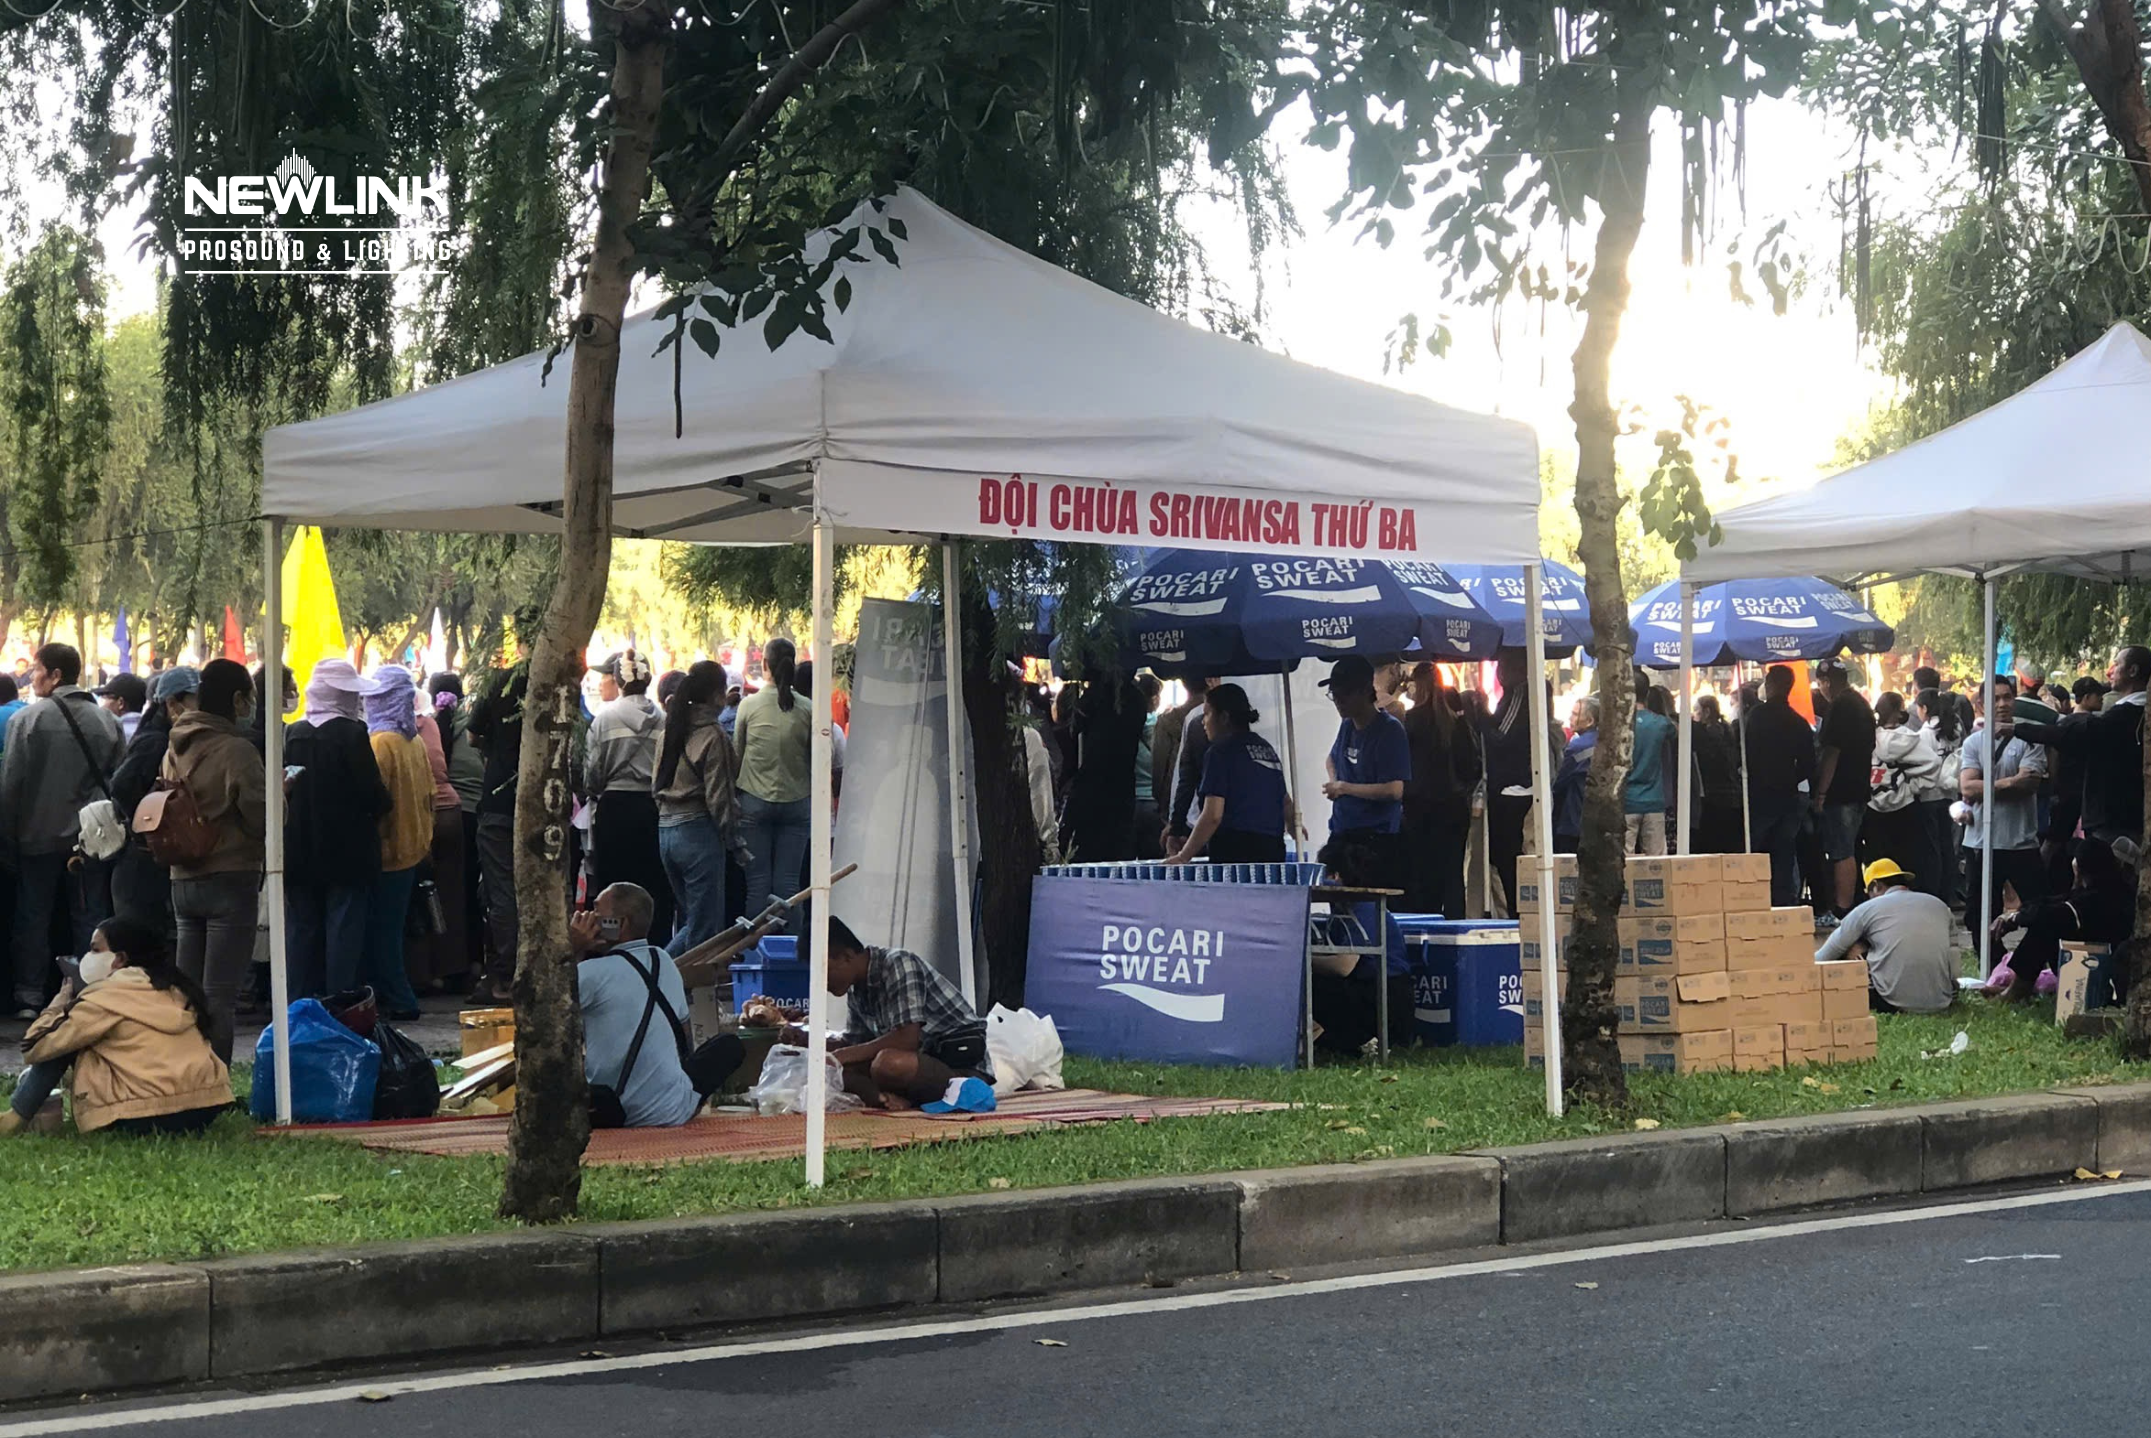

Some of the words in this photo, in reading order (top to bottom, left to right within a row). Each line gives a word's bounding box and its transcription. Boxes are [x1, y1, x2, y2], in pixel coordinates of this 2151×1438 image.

[979, 473, 1038, 535] ĐỘI
[1050, 481, 1139, 535] CHÙA
[1149, 491, 1301, 545] SRIVANSA
[1311, 500, 1374, 549] THỨ
[1378, 507, 1417, 551] BA
[1251, 558, 1365, 576] POCARI
[1136, 567, 1239, 589] POCARI
[1256, 568, 1358, 589] SWEAT
[1393, 569, 1449, 586] SWEAT
[1130, 581, 1225, 602] SWEAT
[1731, 596, 1806, 607] POCARI
[1735, 605, 1802, 616] SWEAT
[1301, 616, 1353, 629] POCARI
[1140, 630, 1184, 642] POCARI
[1303, 625, 1349, 638] SWEAT
[1141, 639, 1180, 651] SWEAT
[1102, 925, 1224, 957] POCARI
[1100, 954, 1211, 985] SWEAT
